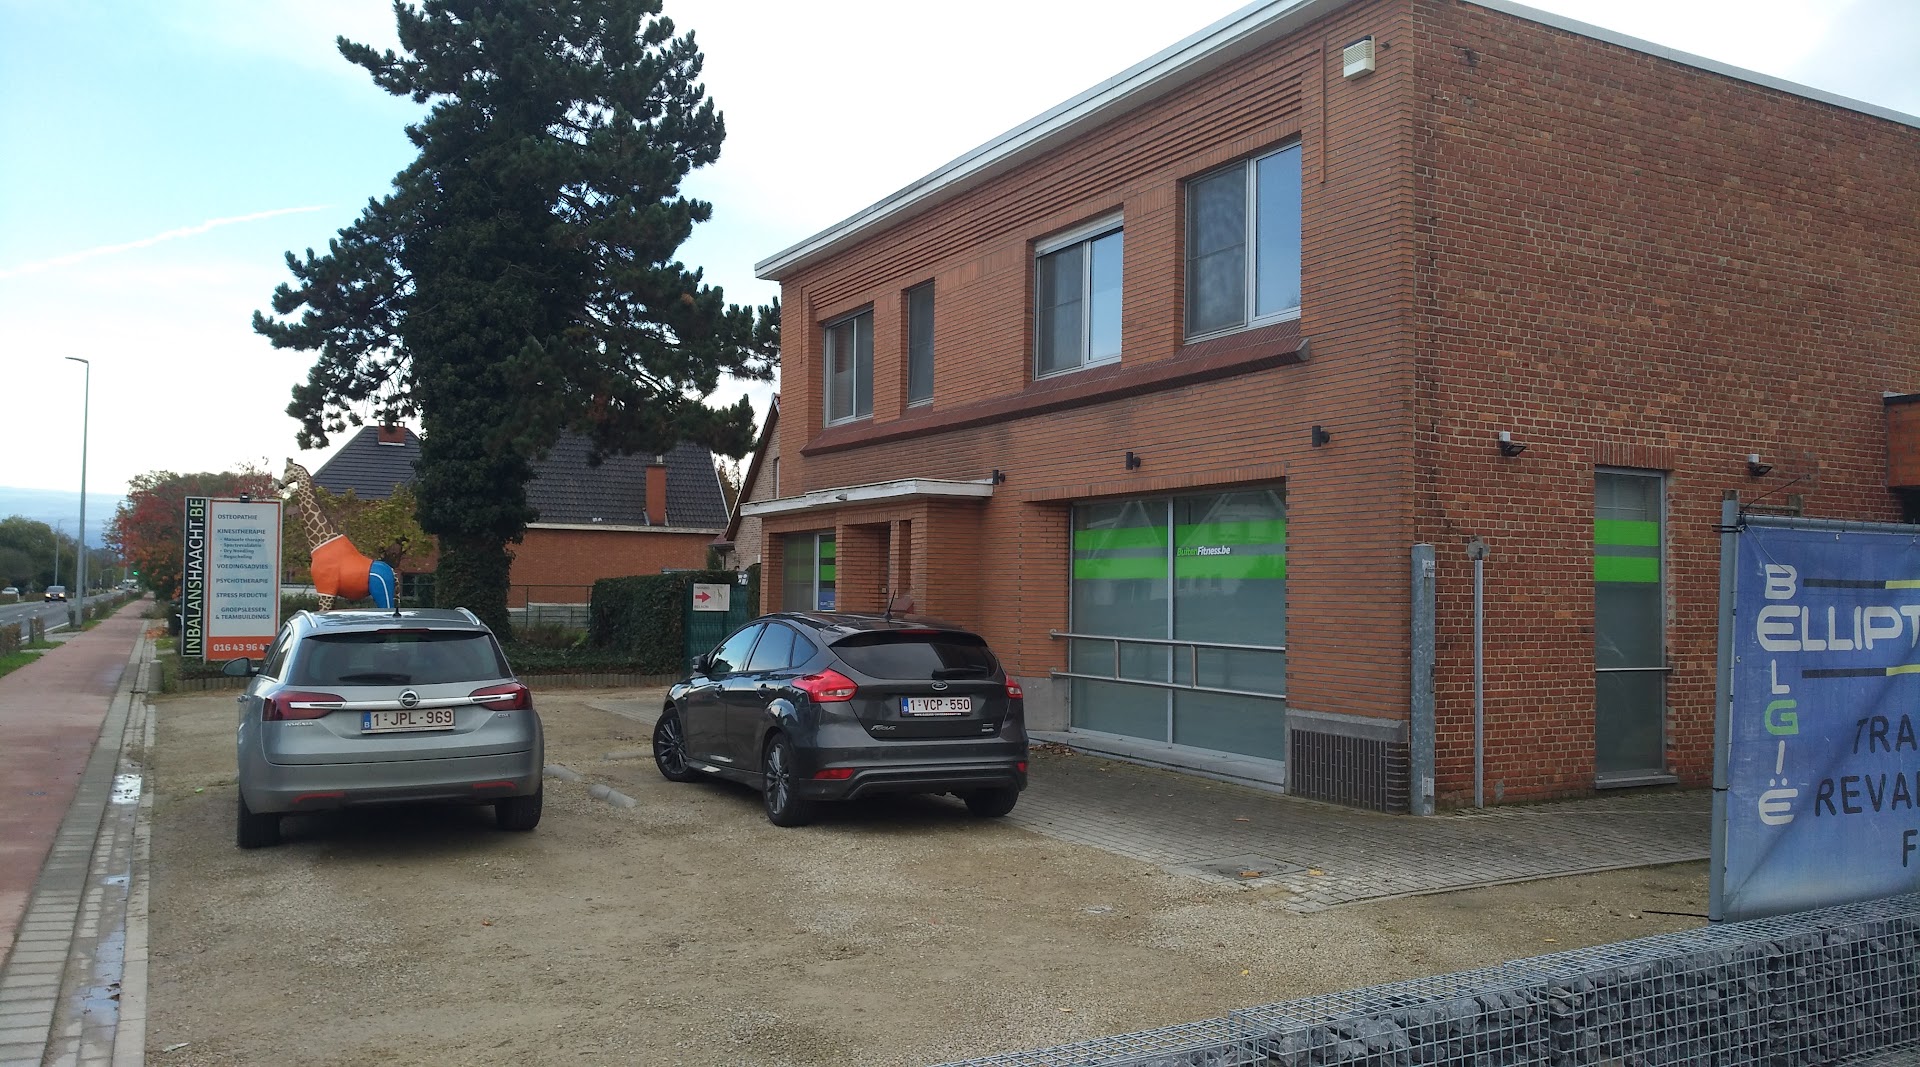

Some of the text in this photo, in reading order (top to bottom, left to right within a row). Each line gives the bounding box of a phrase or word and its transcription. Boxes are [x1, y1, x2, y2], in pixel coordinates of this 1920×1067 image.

[185, 498, 205, 654] INBALANSHAACHT.BE
[213, 643, 231, 652] 016
[232, 643, 244, 652] 43
[246, 643, 258, 652] 96
[910, 698, 970, 711] 1-VCP-550
[373, 710, 452, 727] 1-JPL-969
[1814, 771, 1920, 817] REVA
